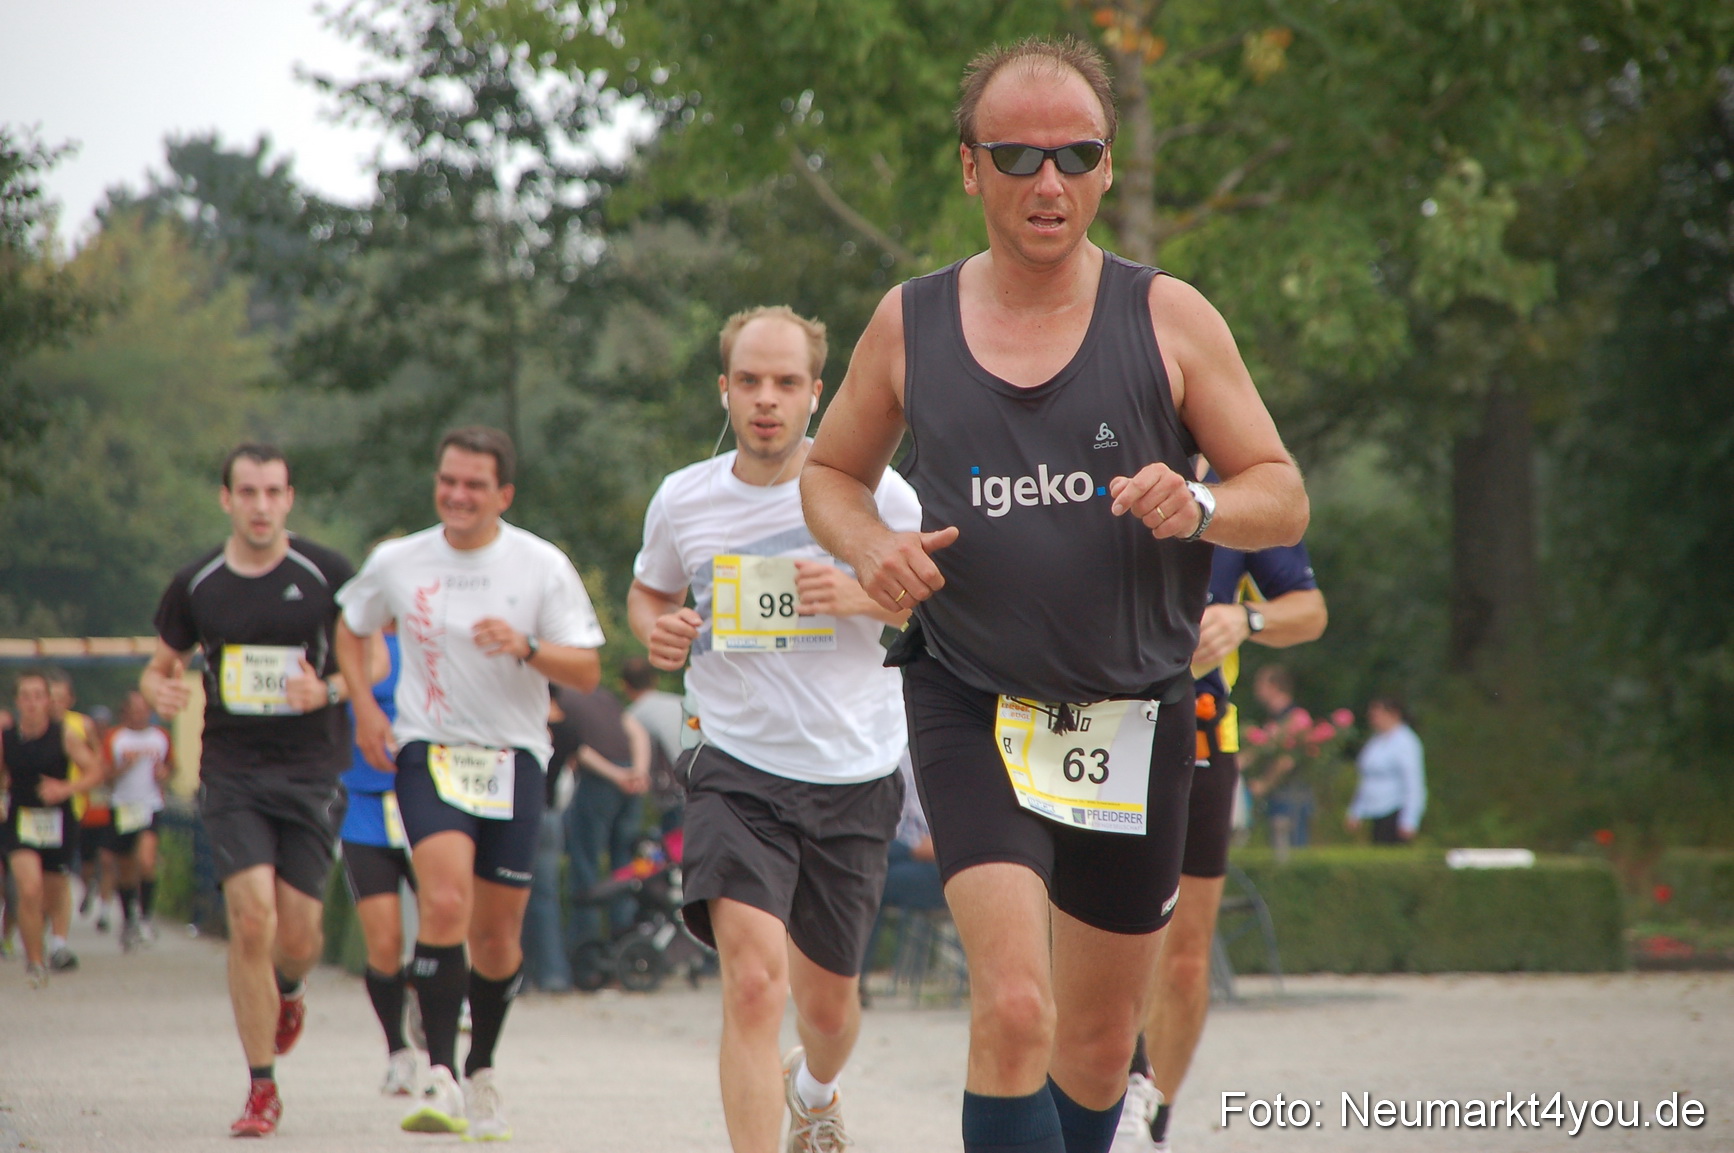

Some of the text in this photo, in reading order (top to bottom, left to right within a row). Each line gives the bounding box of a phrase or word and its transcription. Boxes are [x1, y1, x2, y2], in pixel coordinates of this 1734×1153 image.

[1093, 441, 1119, 450] odlo
[759, 592, 815, 618] 98
[1063, 747, 1110, 784] 63
[461, 774, 499, 795] 156
[1086, 809, 1143, 824] PFLEIDERER
